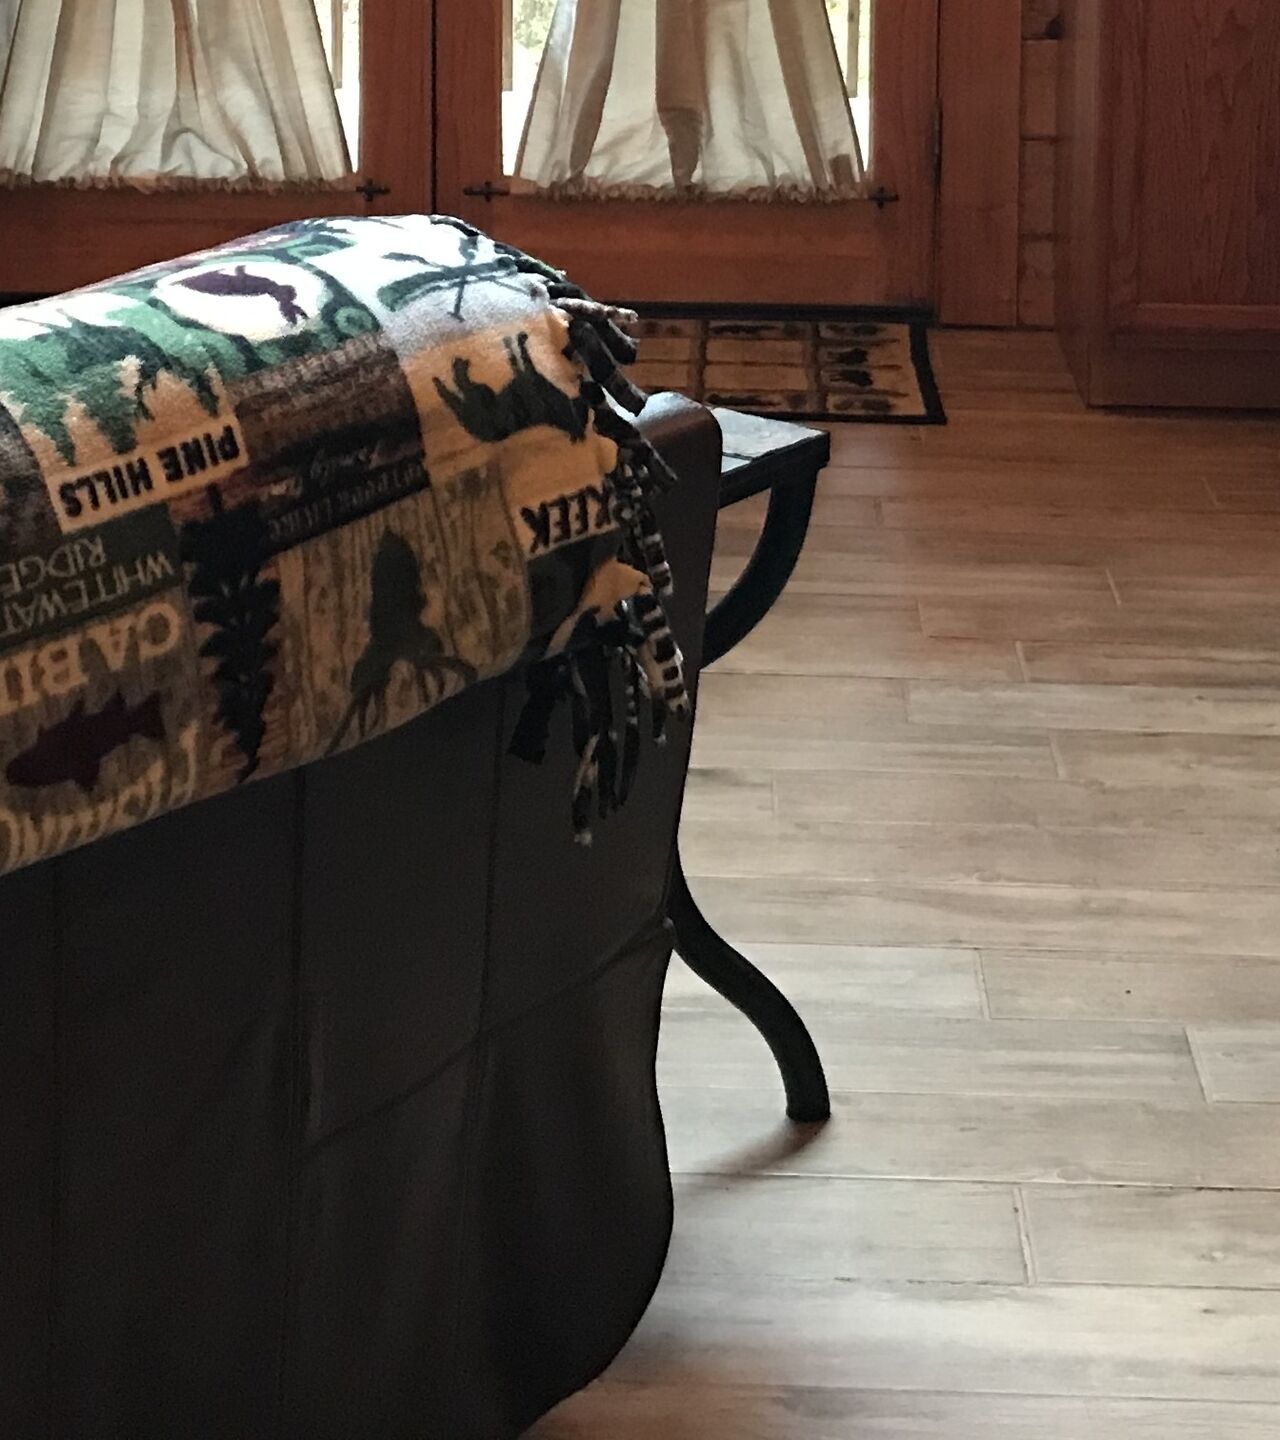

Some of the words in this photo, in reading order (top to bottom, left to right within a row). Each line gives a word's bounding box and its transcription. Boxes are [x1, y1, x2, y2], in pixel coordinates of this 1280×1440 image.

[156, 425, 241, 484] PINE
[57, 458, 154, 518] HILLS
[520, 479, 613, 554] REEK
